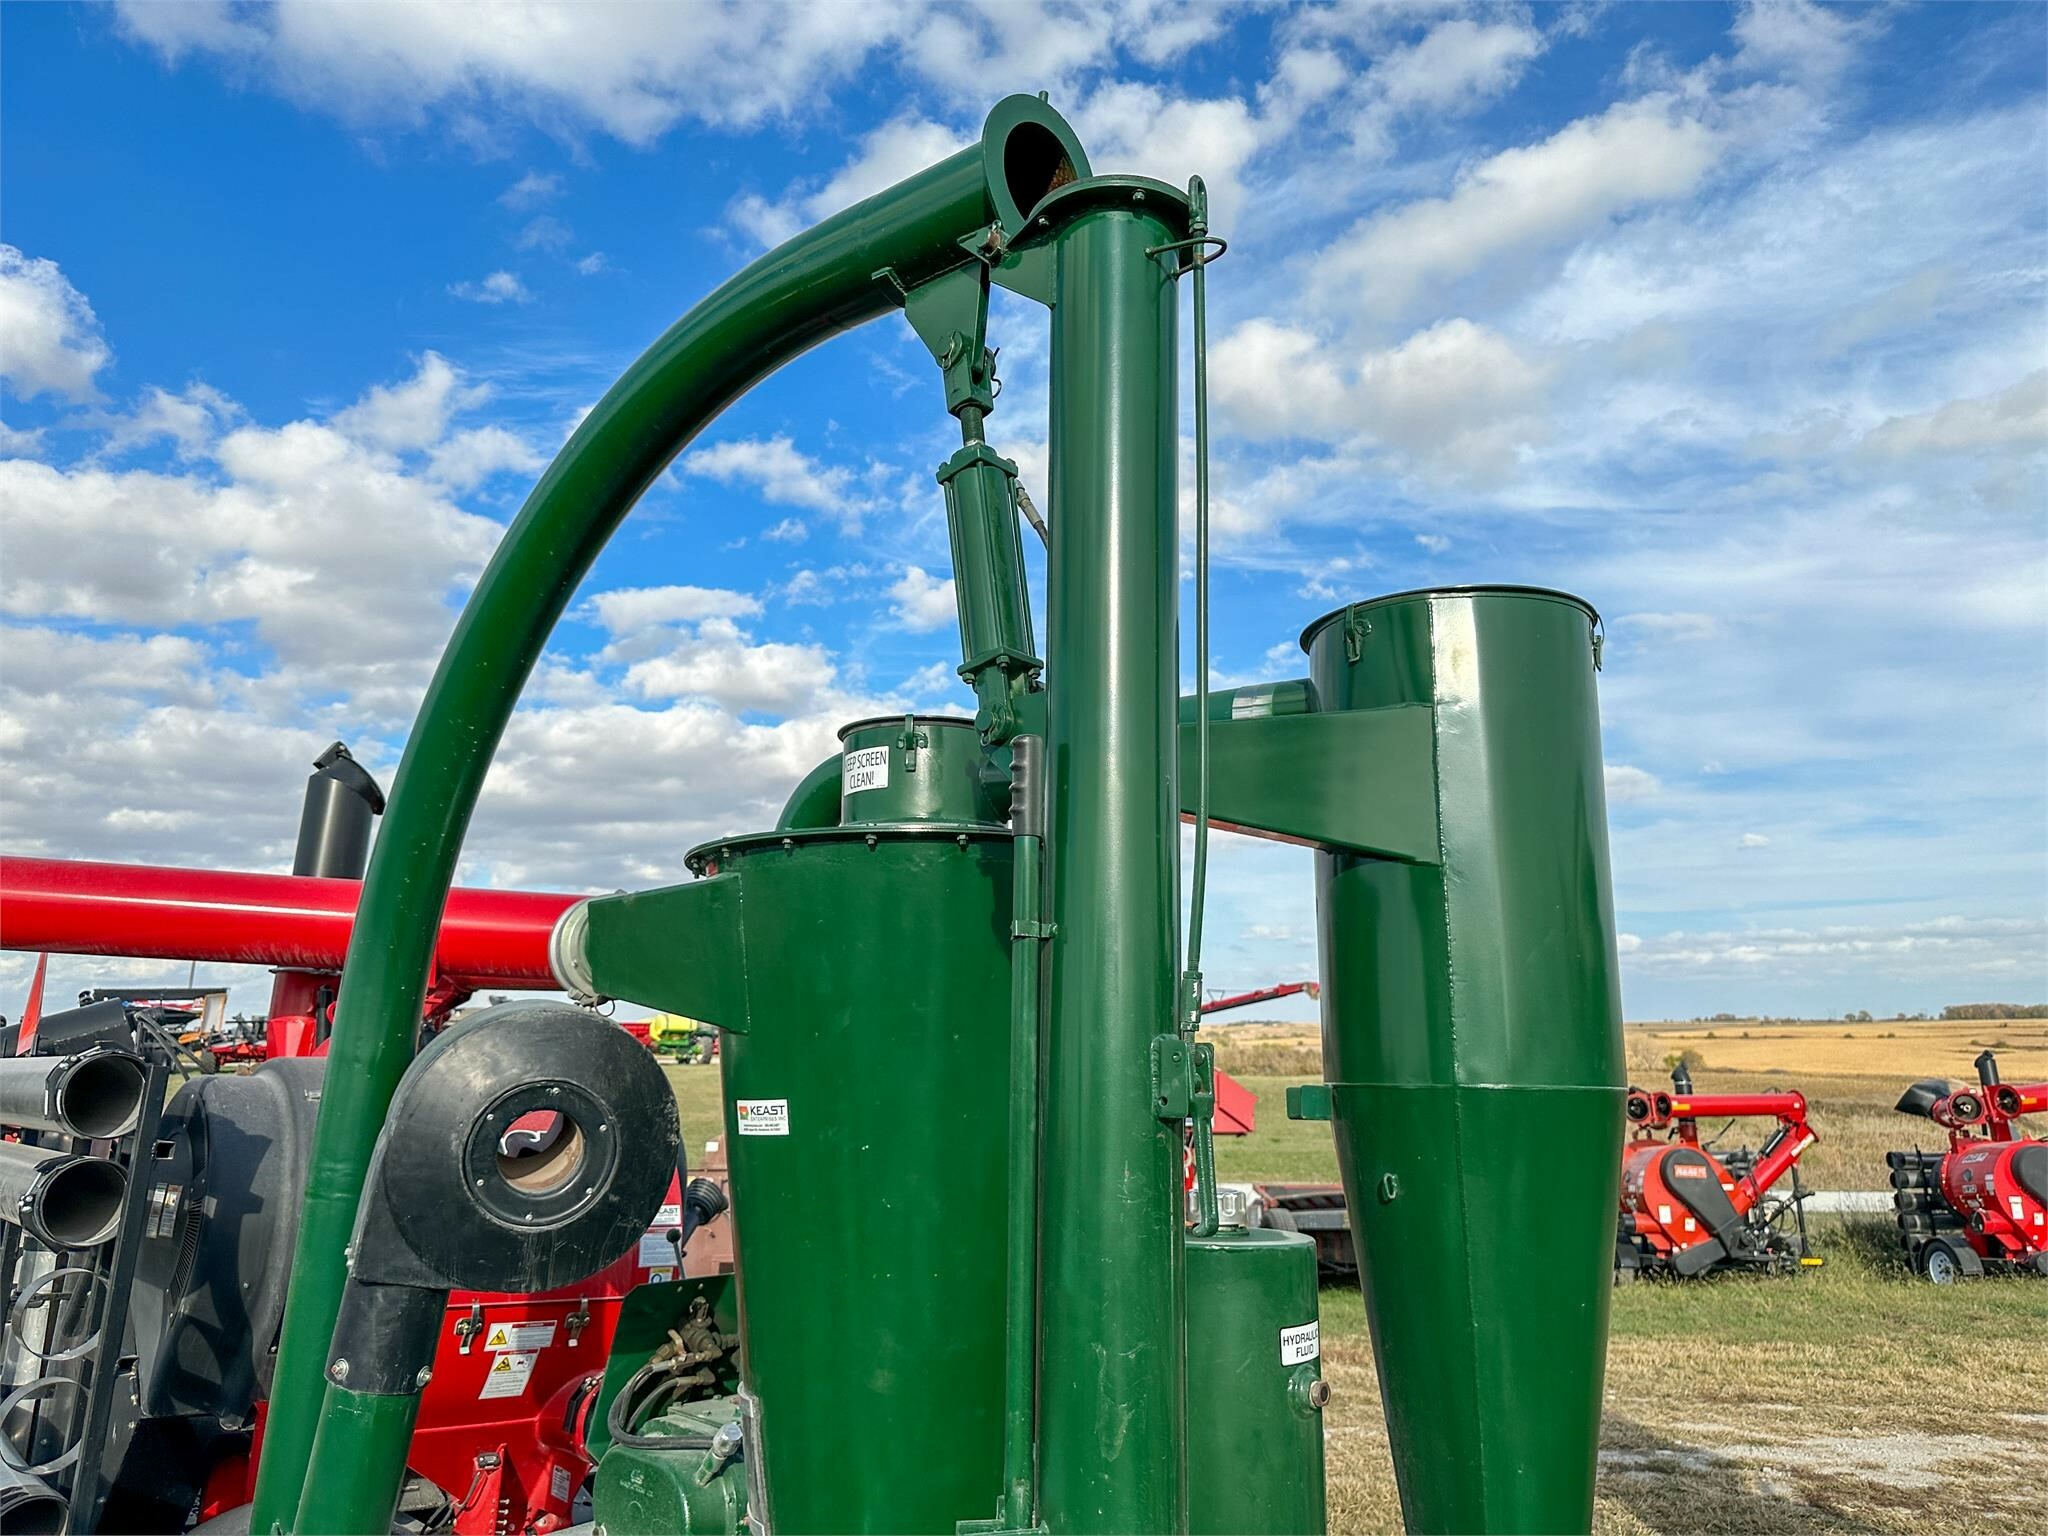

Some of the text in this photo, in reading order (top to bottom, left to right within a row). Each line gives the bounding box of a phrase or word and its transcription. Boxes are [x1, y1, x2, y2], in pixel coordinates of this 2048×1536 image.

[857, 750, 887, 769] SCREEN
[850, 771, 875, 789] CLEAN!
[750, 1105, 786, 1116] KEAST
[1296, 1343, 1314, 1357] FLUID
